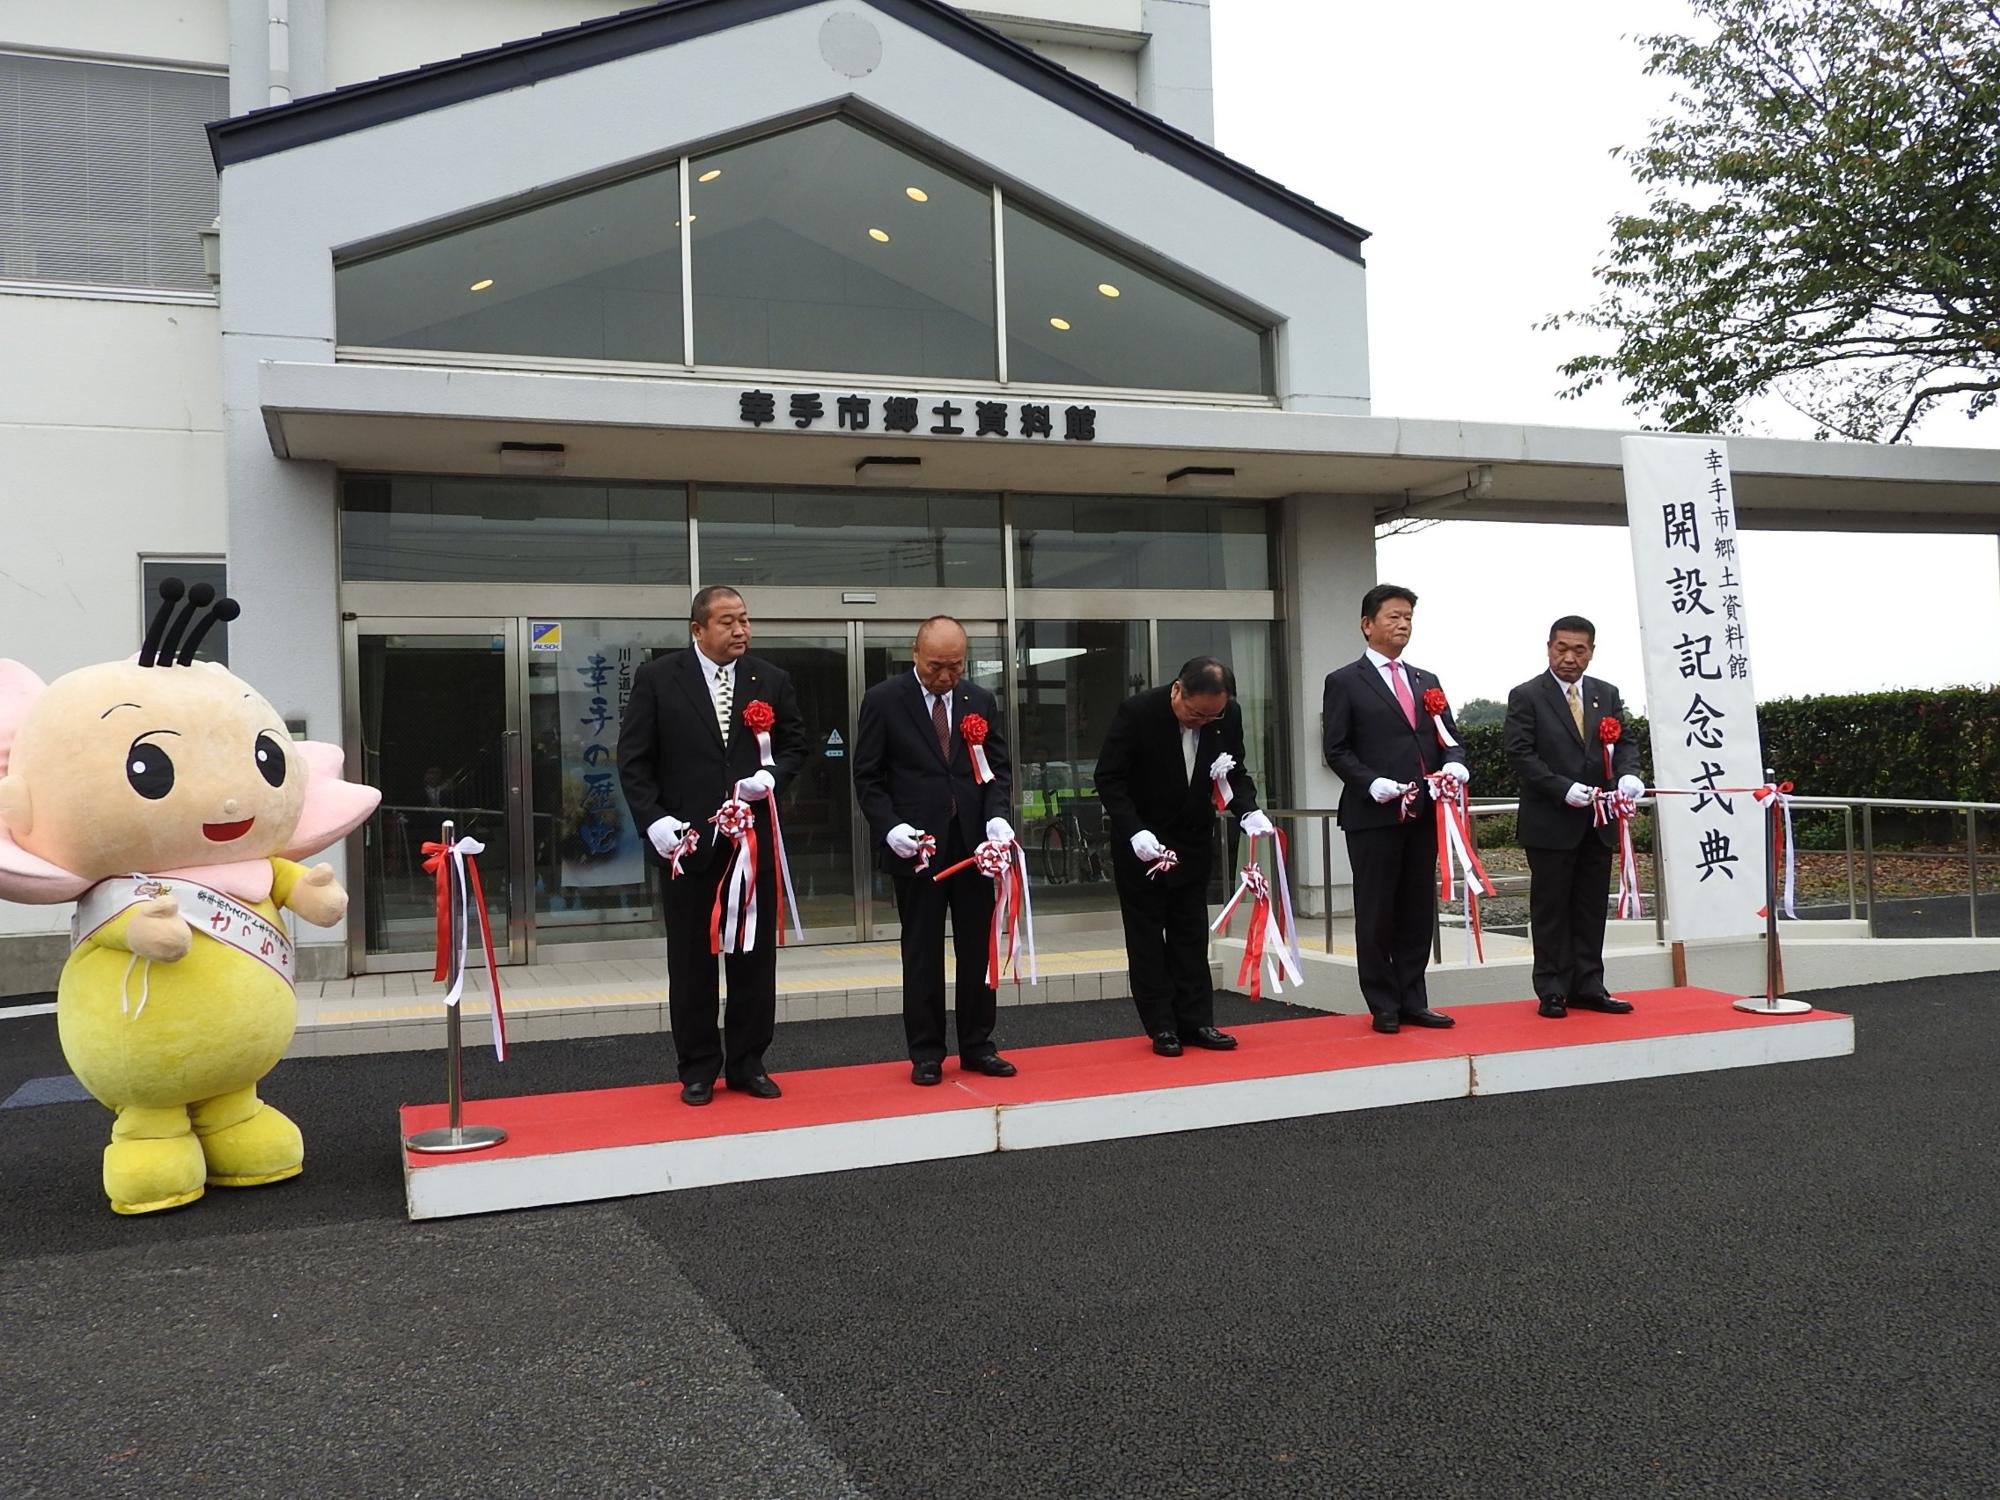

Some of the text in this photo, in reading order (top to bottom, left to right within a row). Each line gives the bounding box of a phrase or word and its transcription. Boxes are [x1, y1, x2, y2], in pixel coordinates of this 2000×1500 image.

[739, 389, 1096, 441] 幸手市郷土資料館
[1704, 448, 1748, 680] 幸手市郷土資料館
[577, 654, 616, 856] 幸手の歴史
[1662, 501, 1739, 883] 開設記念式典
